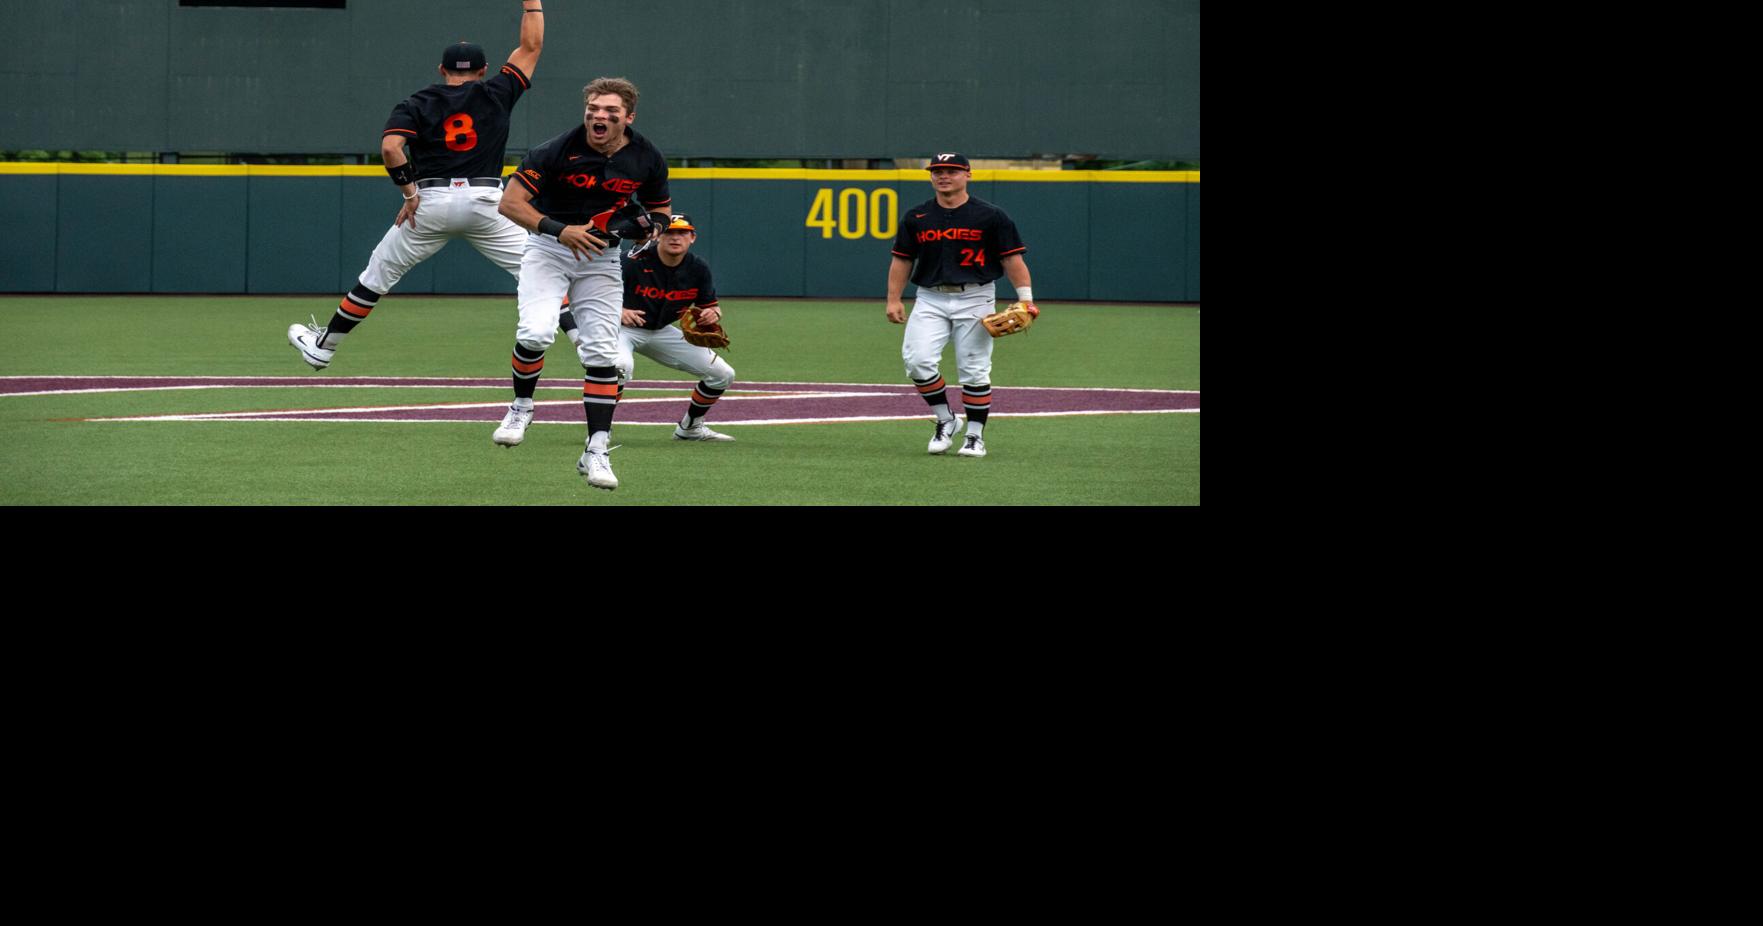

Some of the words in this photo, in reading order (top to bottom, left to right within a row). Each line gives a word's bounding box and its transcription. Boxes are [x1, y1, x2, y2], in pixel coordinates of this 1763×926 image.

[444, 112, 477, 151] 8
[937, 153, 955, 161] VT
[805, 187, 898, 239] 400
[916, 228, 983, 243] HOKIES
[960, 248, 985, 267] 24
[633, 284, 699, 300] HOKIES
